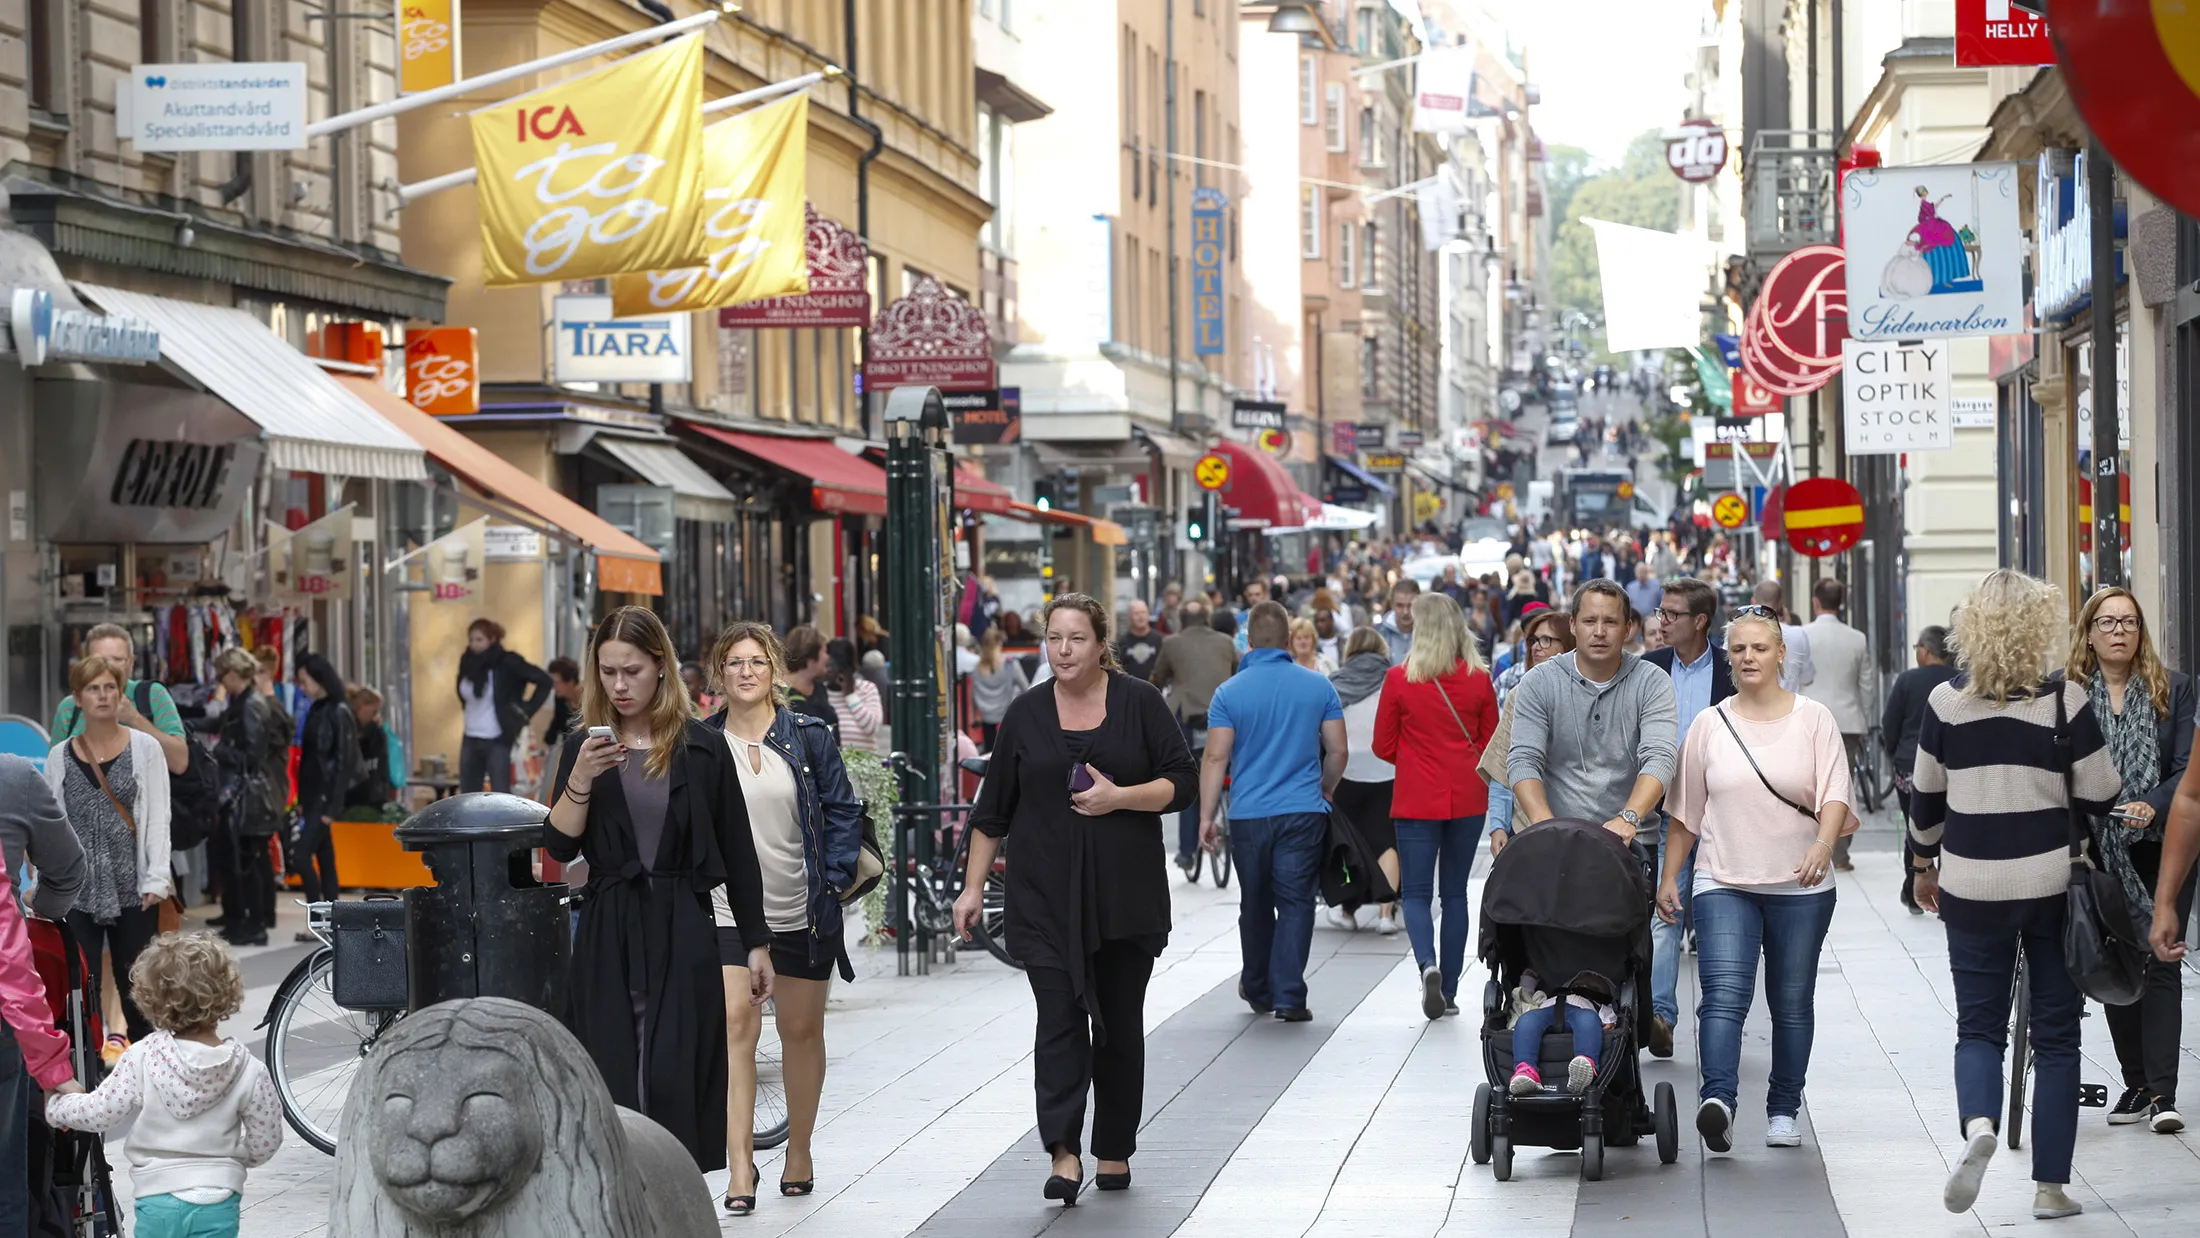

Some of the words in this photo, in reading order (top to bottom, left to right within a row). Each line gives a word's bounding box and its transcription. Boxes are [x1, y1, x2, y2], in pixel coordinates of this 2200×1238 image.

[401, 19, 448, 39] to
[1985, 23, 2038, 38] HELLY
[404, 38, 449, 60] go
[164, 101, 271, 117] Akuttandvård
[145, 122, 290, 141] Specialisttandvård
[517, 104, 588, 142] ICA
[513, 141, 667, 204] to
[523, 198, 669, 276] go
[1195, 217, 1221, 346] HOTEL
[1859, 303, 2008, 338] Sidencarlson
[561, 320, 679, 356] TIARA
[410, 355, 469, 380] to
[866, 361, 988, 375] DROTTNINGHOF
[1856, 350, 1938, 374] CITY
[413, 378, 470, 407] go
[1857, 382, 1936, 402] OPTIK
[1860, 410, 1938, 426] STOCK
[110, 438, 236, 510] CREOLE
